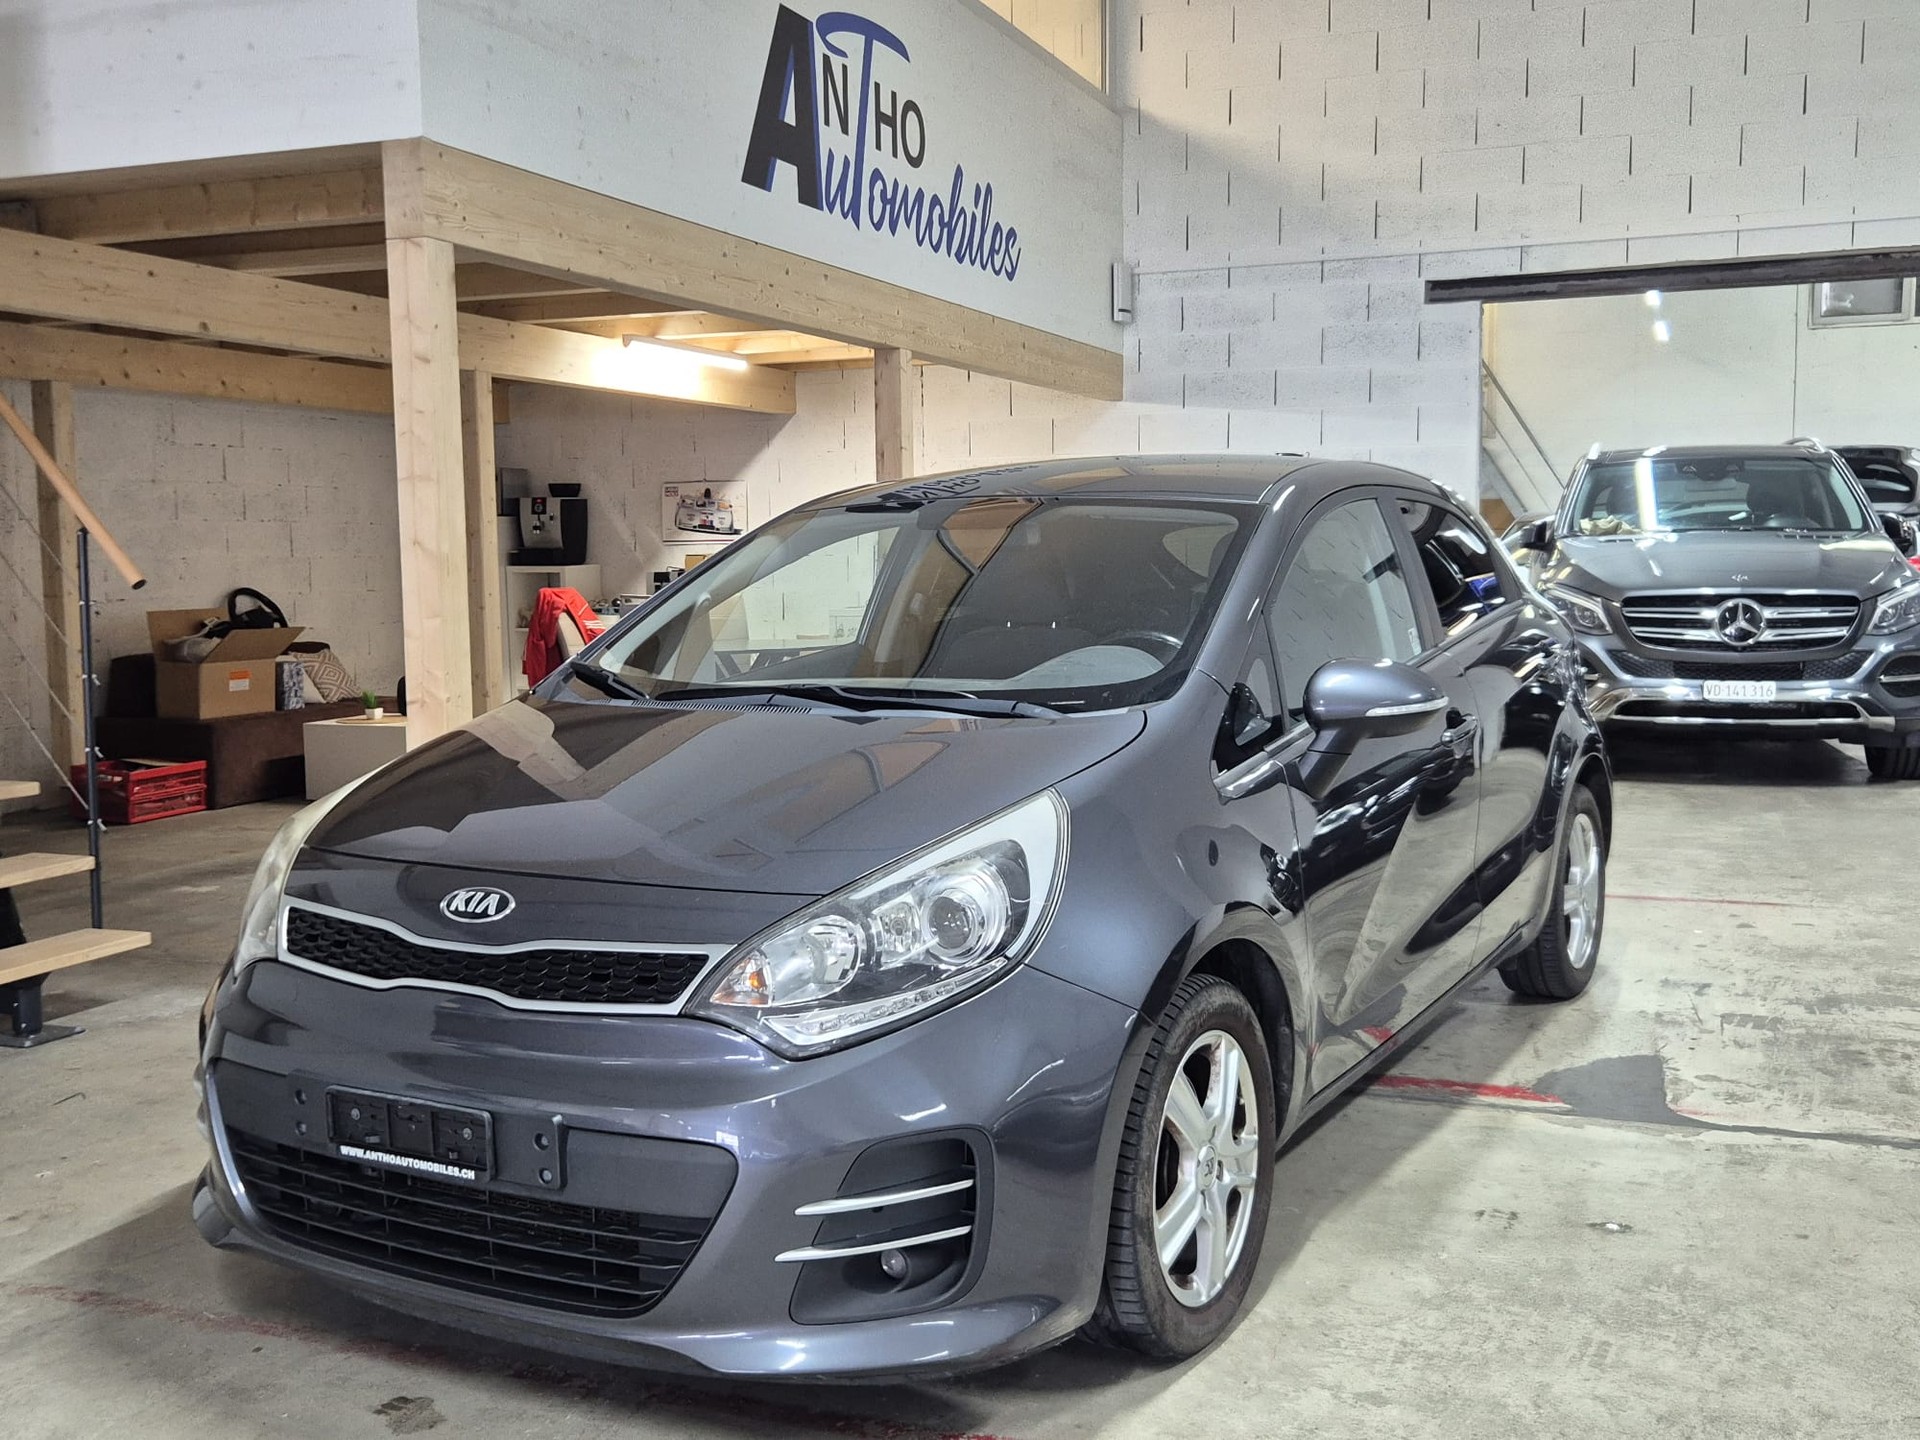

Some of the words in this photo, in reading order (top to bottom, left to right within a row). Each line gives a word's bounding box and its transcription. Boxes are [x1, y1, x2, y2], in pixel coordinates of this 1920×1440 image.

[741, 3, 926, 220] ANTHO
[1706, 684, 1720, 696] VD
[449, 891, 500, 916] KIA
[340, 1145, 475, 1180] WWW.ANTHOAUTOMOBILES.CH
